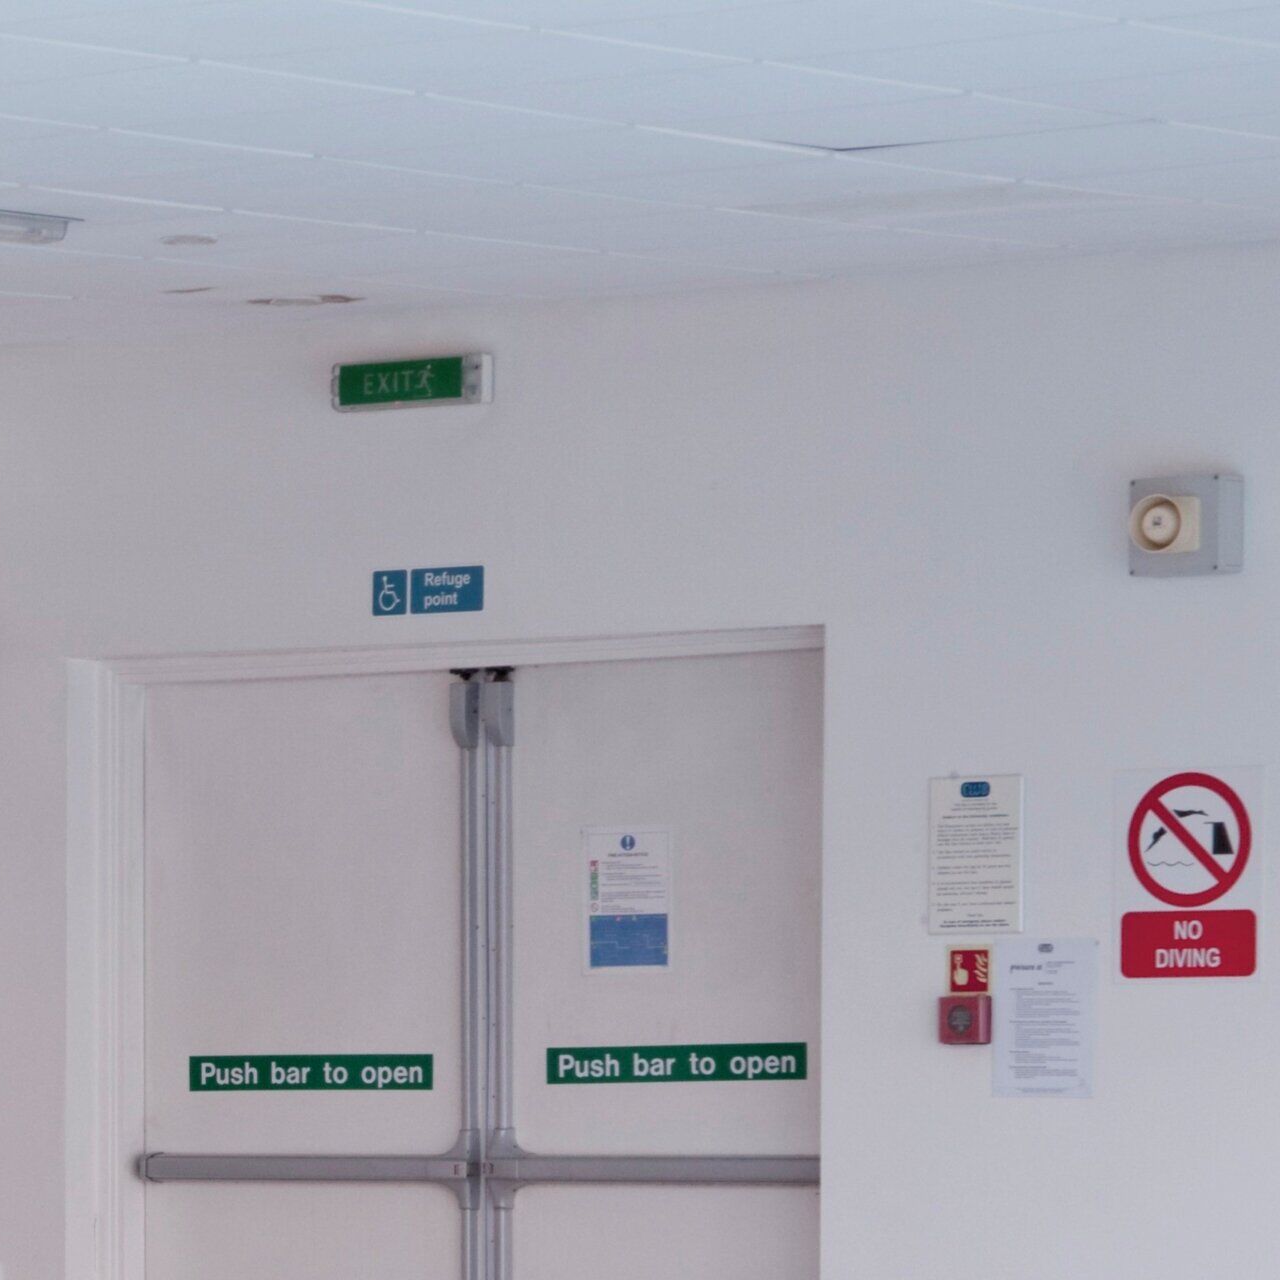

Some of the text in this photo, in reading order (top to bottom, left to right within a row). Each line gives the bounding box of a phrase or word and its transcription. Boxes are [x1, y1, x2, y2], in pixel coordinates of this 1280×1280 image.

[363, 370, 413, 395] EXIT
[424, 571, 471, 588] Refuge
[424, 592, 458, 609] point
[1173, 920, 1203, 940] NO
[1155, 948, 1221, 968] DIVING
[200, 1061, 423, 1089] Push bar to open
[558, 1052, 796, 1079] Push bar to open
